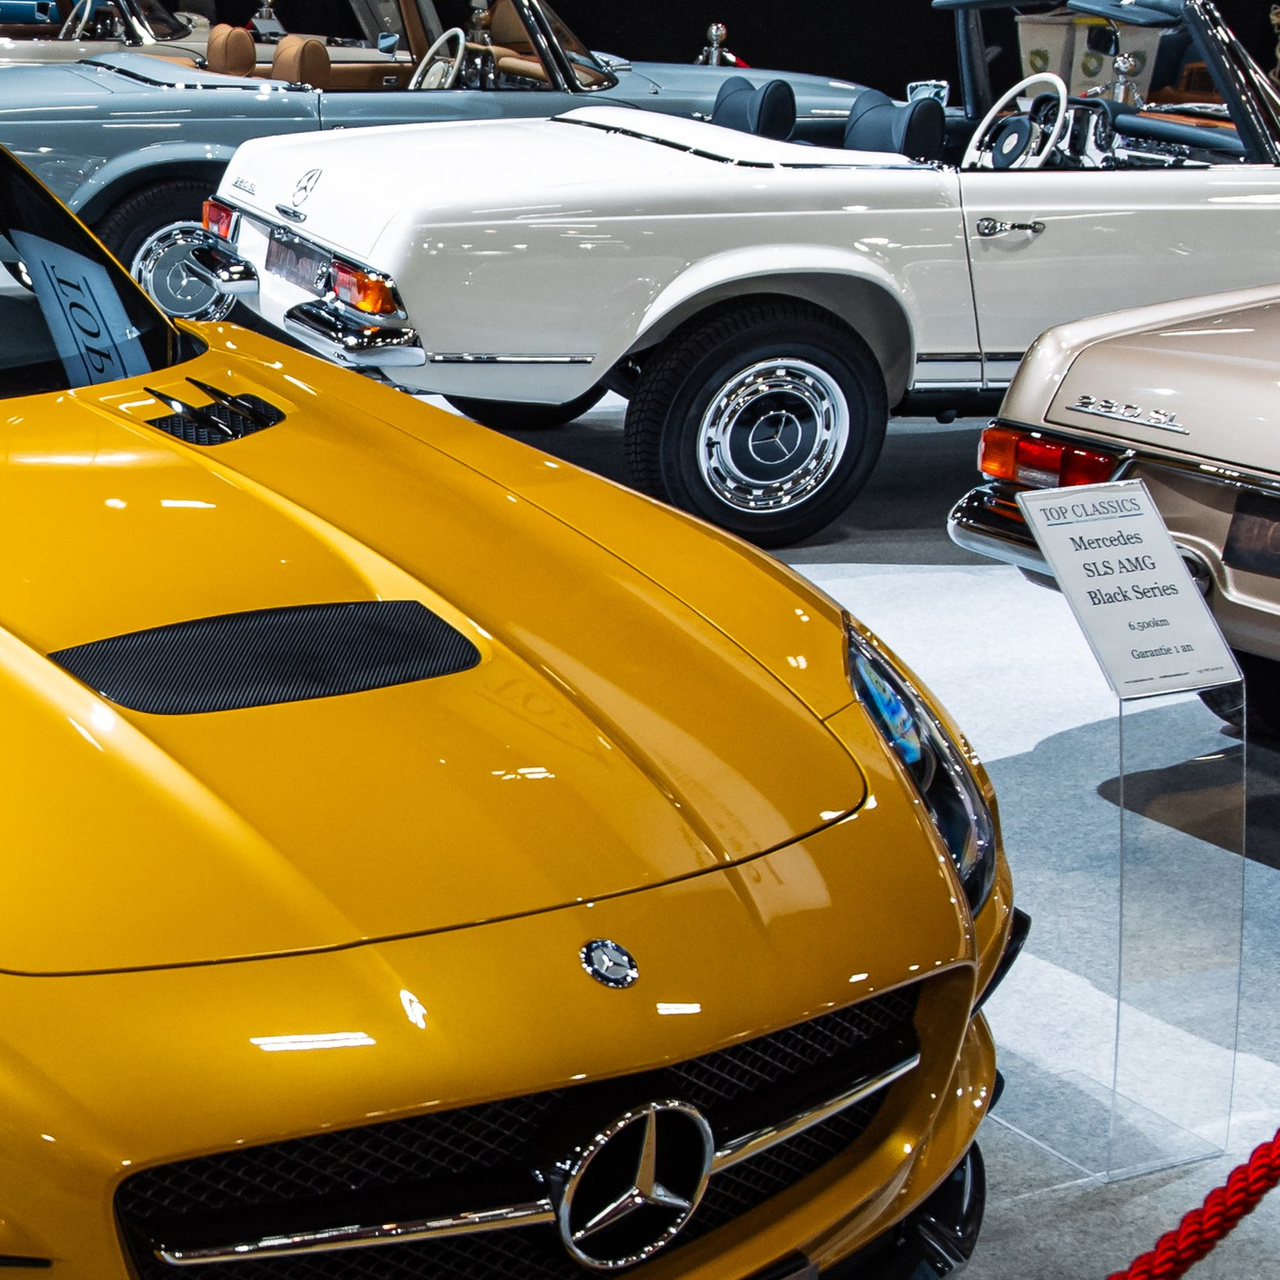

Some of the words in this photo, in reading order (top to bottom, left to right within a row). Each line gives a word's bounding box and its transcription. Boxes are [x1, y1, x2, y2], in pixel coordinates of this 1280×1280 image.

[1147, 409, 1184, 428] SL
[1040, 504, 1068, 522] TOP
[1071, 498, 1141, 518] CLASSICS
[1069, 530, 1143, 552] Mercedes
[1082, 562, 1114, 578] SLS
[1118, 555, 1156, 574] AMG
[1086, 586, 1132, 606] Black
[1132, 581, 1179, 600] Series
[1131, 645, 1173, 660] Garantie
[1180, 644, 1194, 653] an
